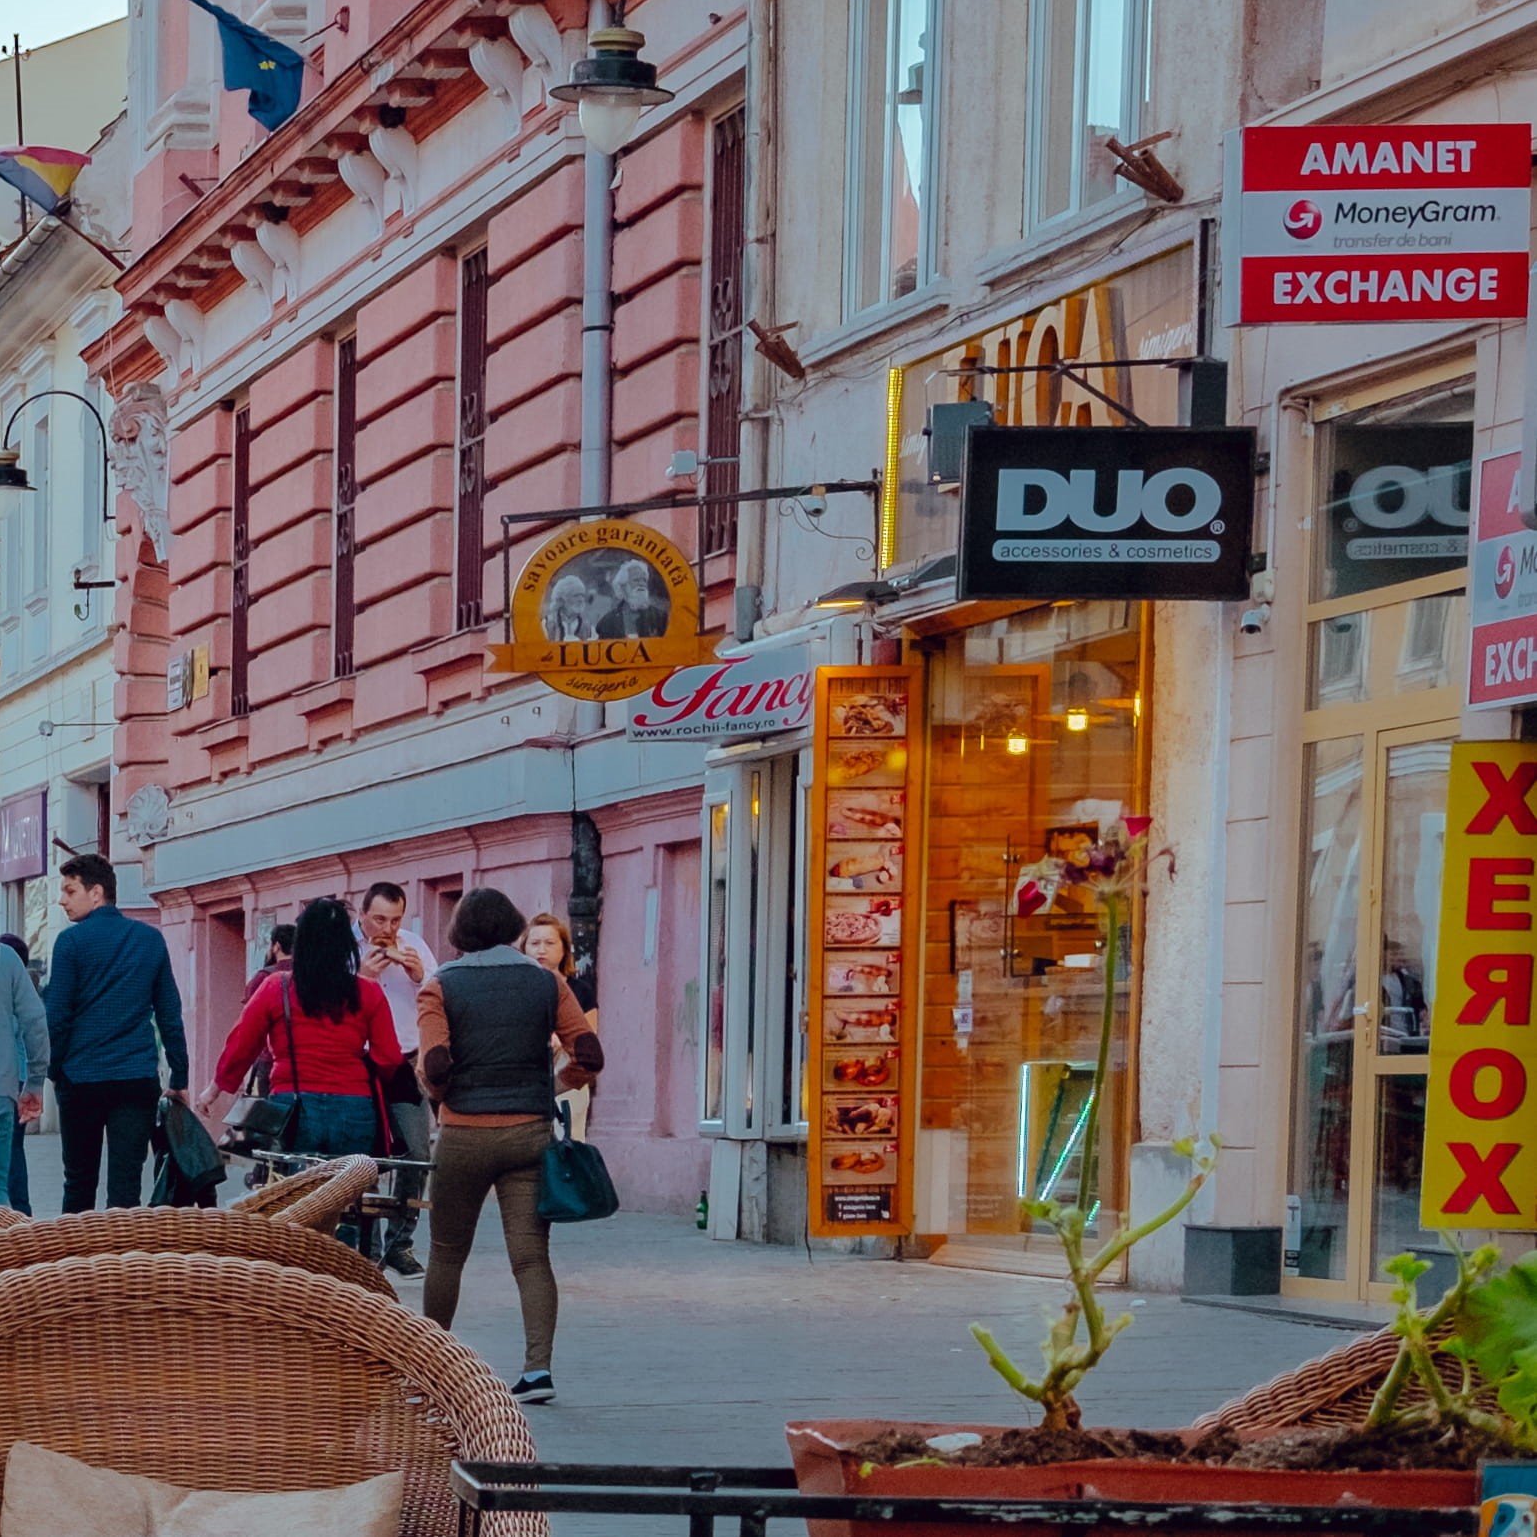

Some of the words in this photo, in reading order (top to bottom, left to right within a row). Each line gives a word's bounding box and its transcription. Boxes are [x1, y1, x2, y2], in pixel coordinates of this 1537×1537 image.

[1300, 140, 1477, 175] AMANET
[1334, 200, 1497, 228] MoneyGram
[1333, 233, 1395, 249] transfer
[1397, 233, 1416, 248] de
[1418, 233, 1453, 247] bani
[1272, 267, 1499, 305] EXCHANGE
[995, 467, 1222, 532] DUO
[523, 528, 590, 592] savoare
[1000, 544, 1102, 559] accessories
[1108, 543, 1120, 559] &
[1126, 544, 1213, 559] cosmetics
[557, 639, 652, 667] LUCA
[633, 654, 814, 727] Fancy
[632, 718, 775, 738] www.rochii-fancy.ro
